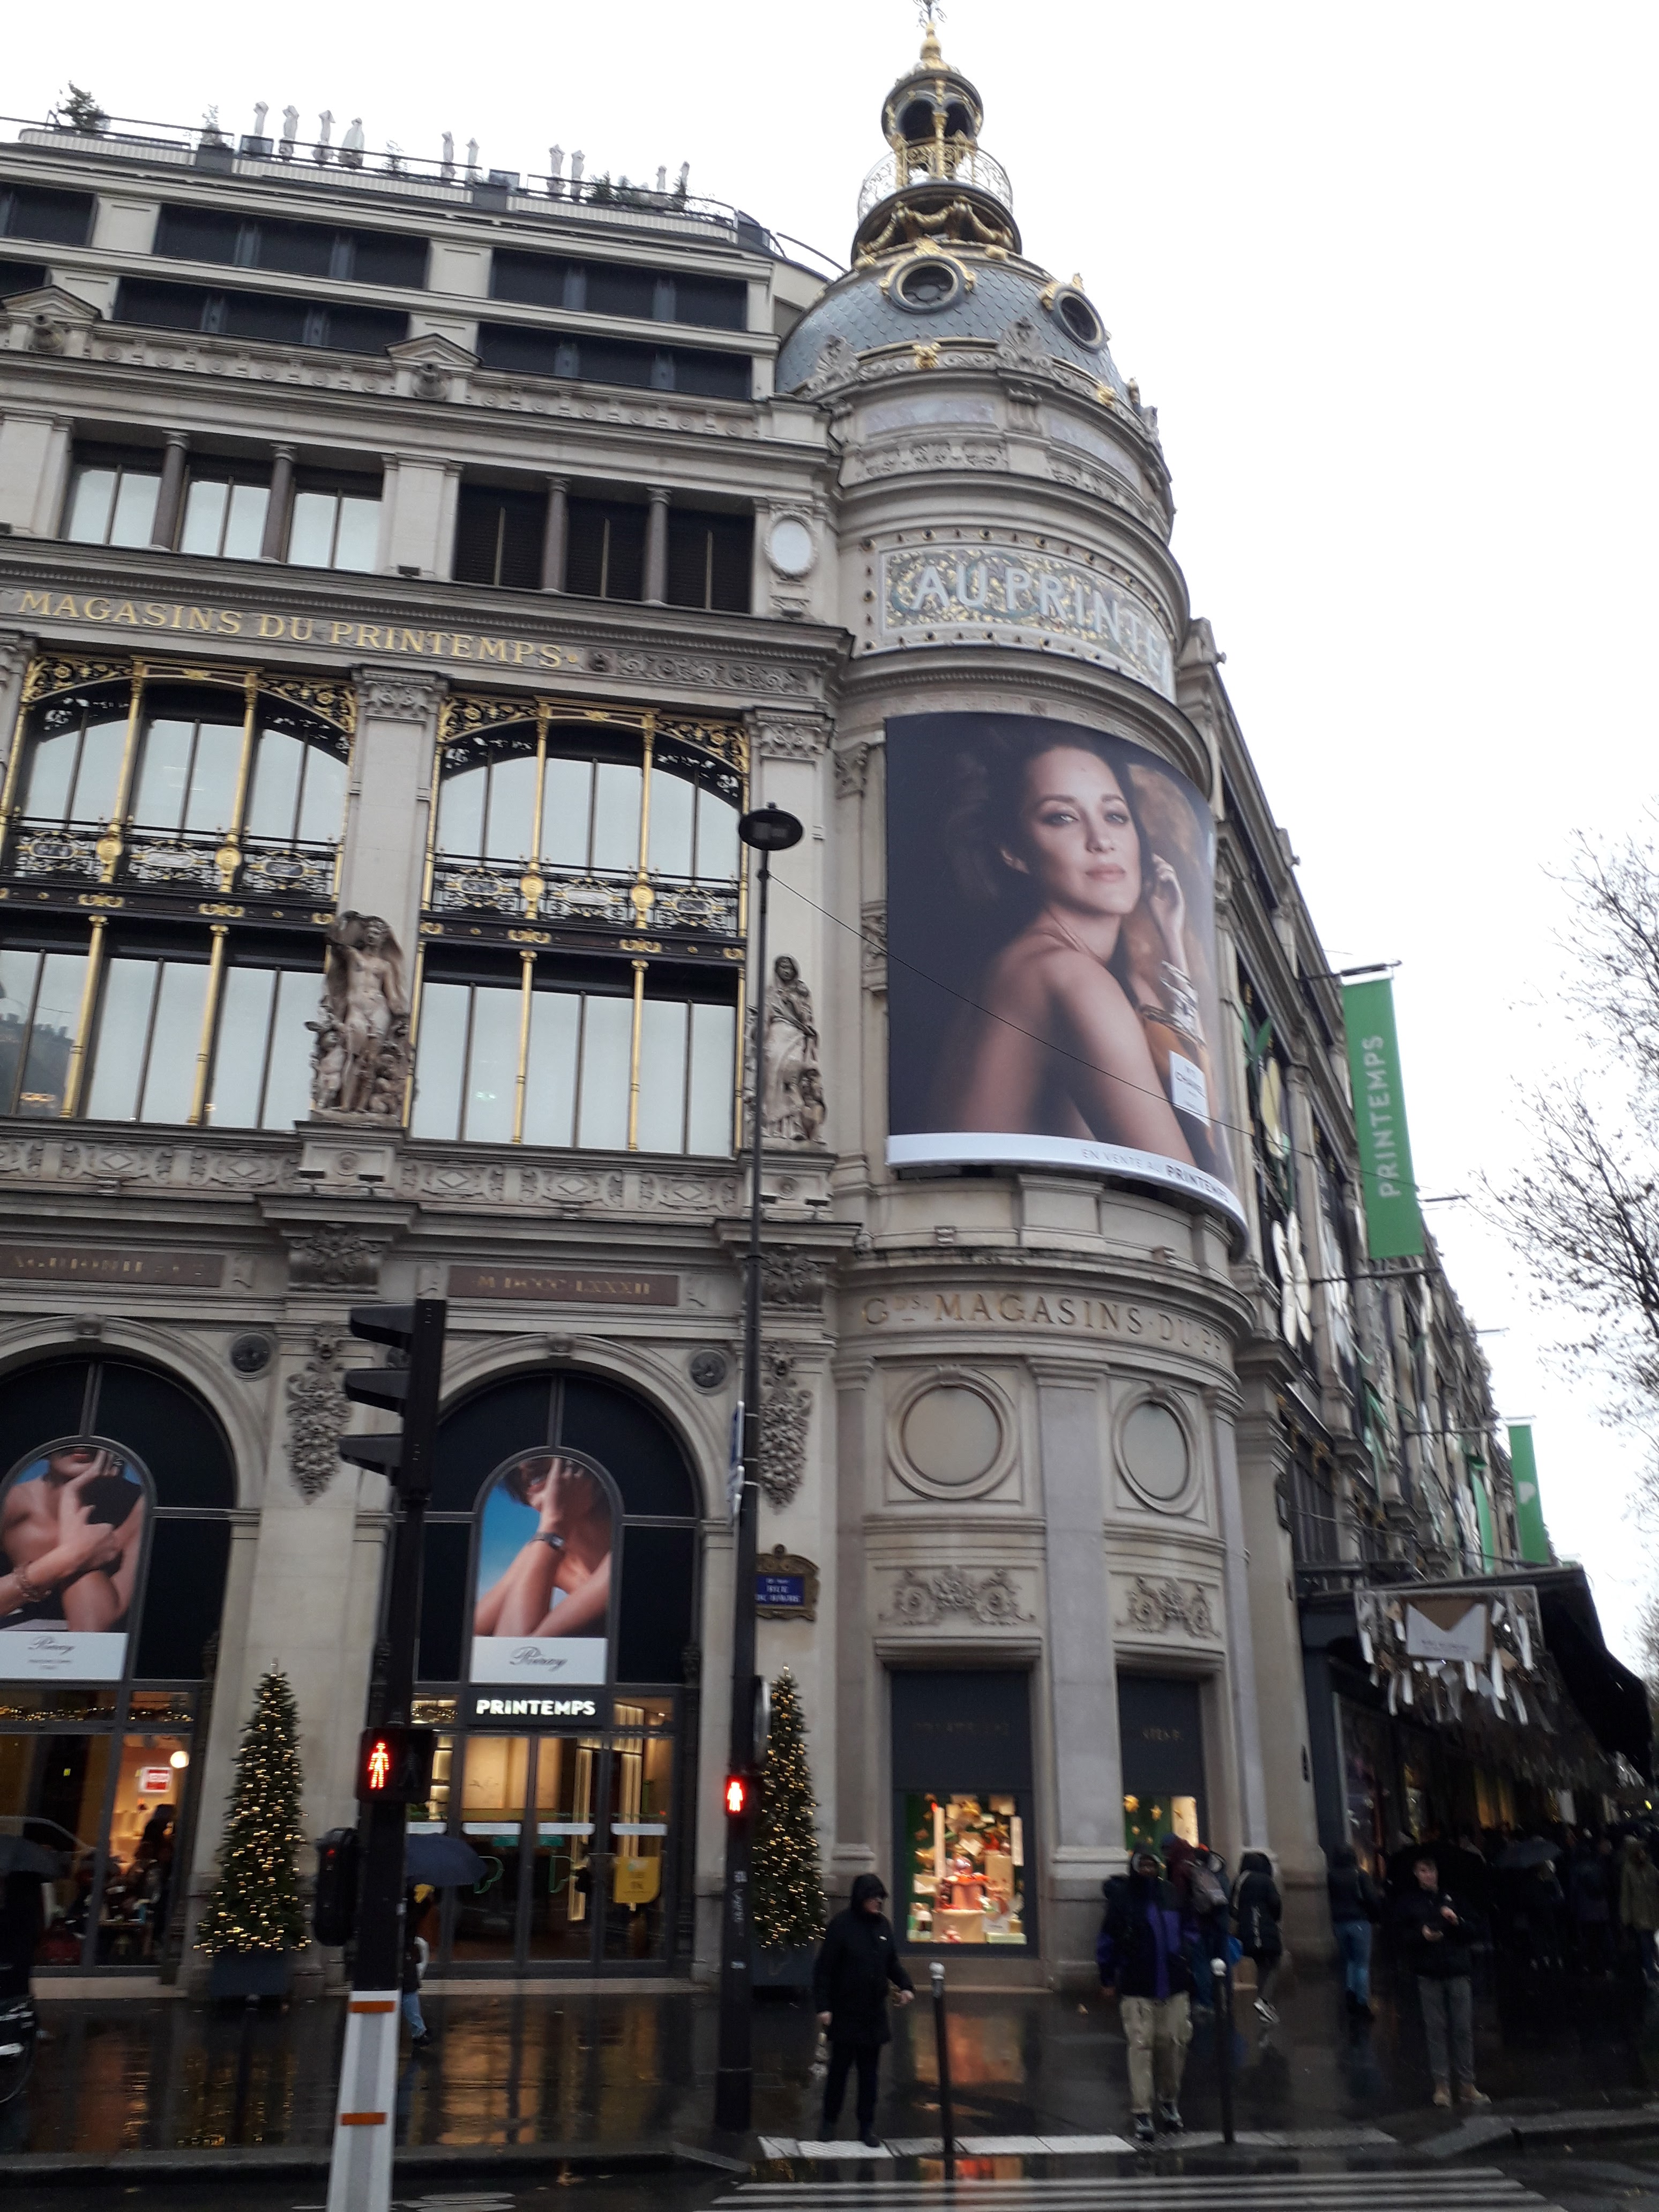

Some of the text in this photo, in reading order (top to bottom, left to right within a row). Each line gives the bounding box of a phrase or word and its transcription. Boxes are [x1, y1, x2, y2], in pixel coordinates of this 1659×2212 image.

[911, 562, 988, 611] AU
[17, 590, 563, 669] MAGASINS DU PRINTEMPS
[1361, 1035, 1401, 1198] PRINTEMPS
[1082, 1148, 1100, 1161] EN
[1102, 1152, 1142, 1168] VENTE
[934, 1292, 1144, 1335] MAGASINS
[476, 1699, 596, 1716] PRINTEMPS
